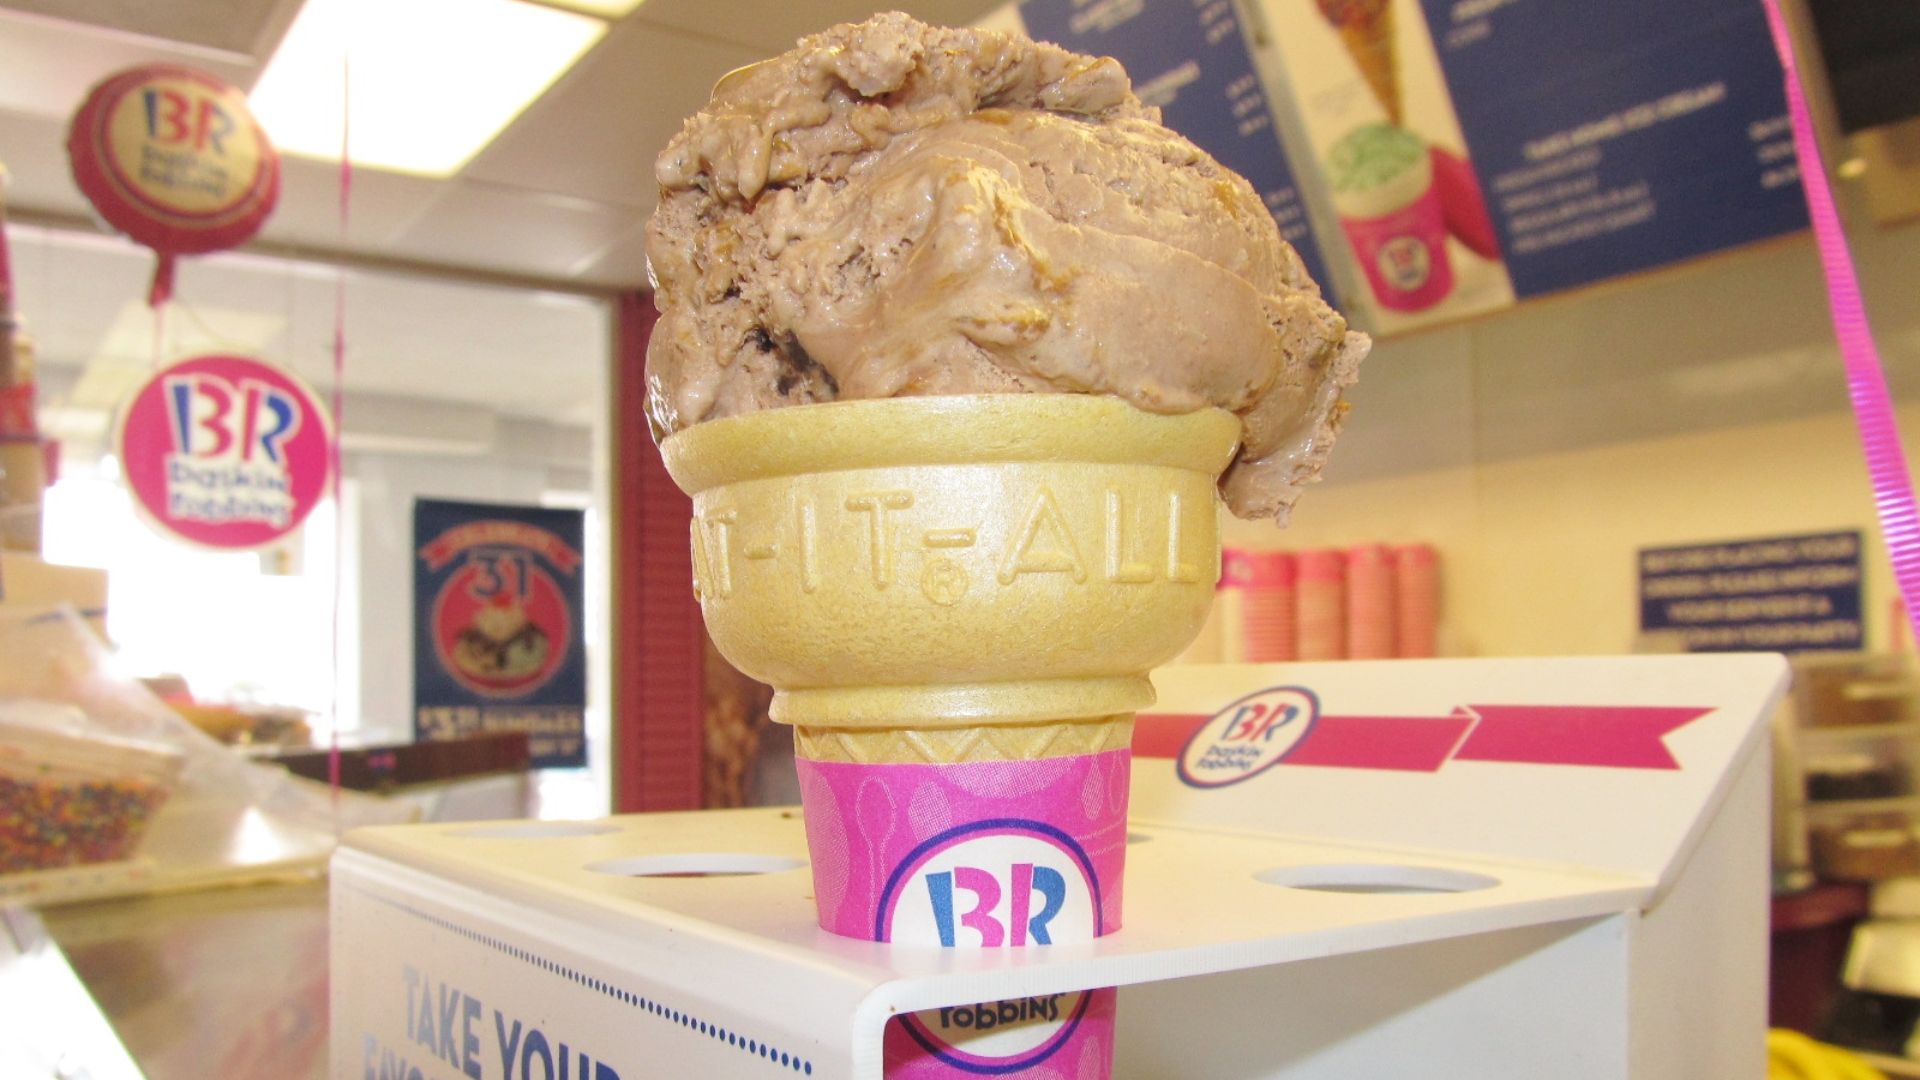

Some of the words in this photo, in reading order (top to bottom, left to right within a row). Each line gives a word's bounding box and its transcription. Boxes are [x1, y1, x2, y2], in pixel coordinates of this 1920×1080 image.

[144, 87, 236, 157] BR
[173, 382, 293, 463] BR
[473, 555, 528, 597] 31
[1221, 702, 1299, 742] BR
[925, 863, 1067, 947] BR
[402, 963, 482, 1080] TAKE
[494, 1009, 621, 1080] YO
